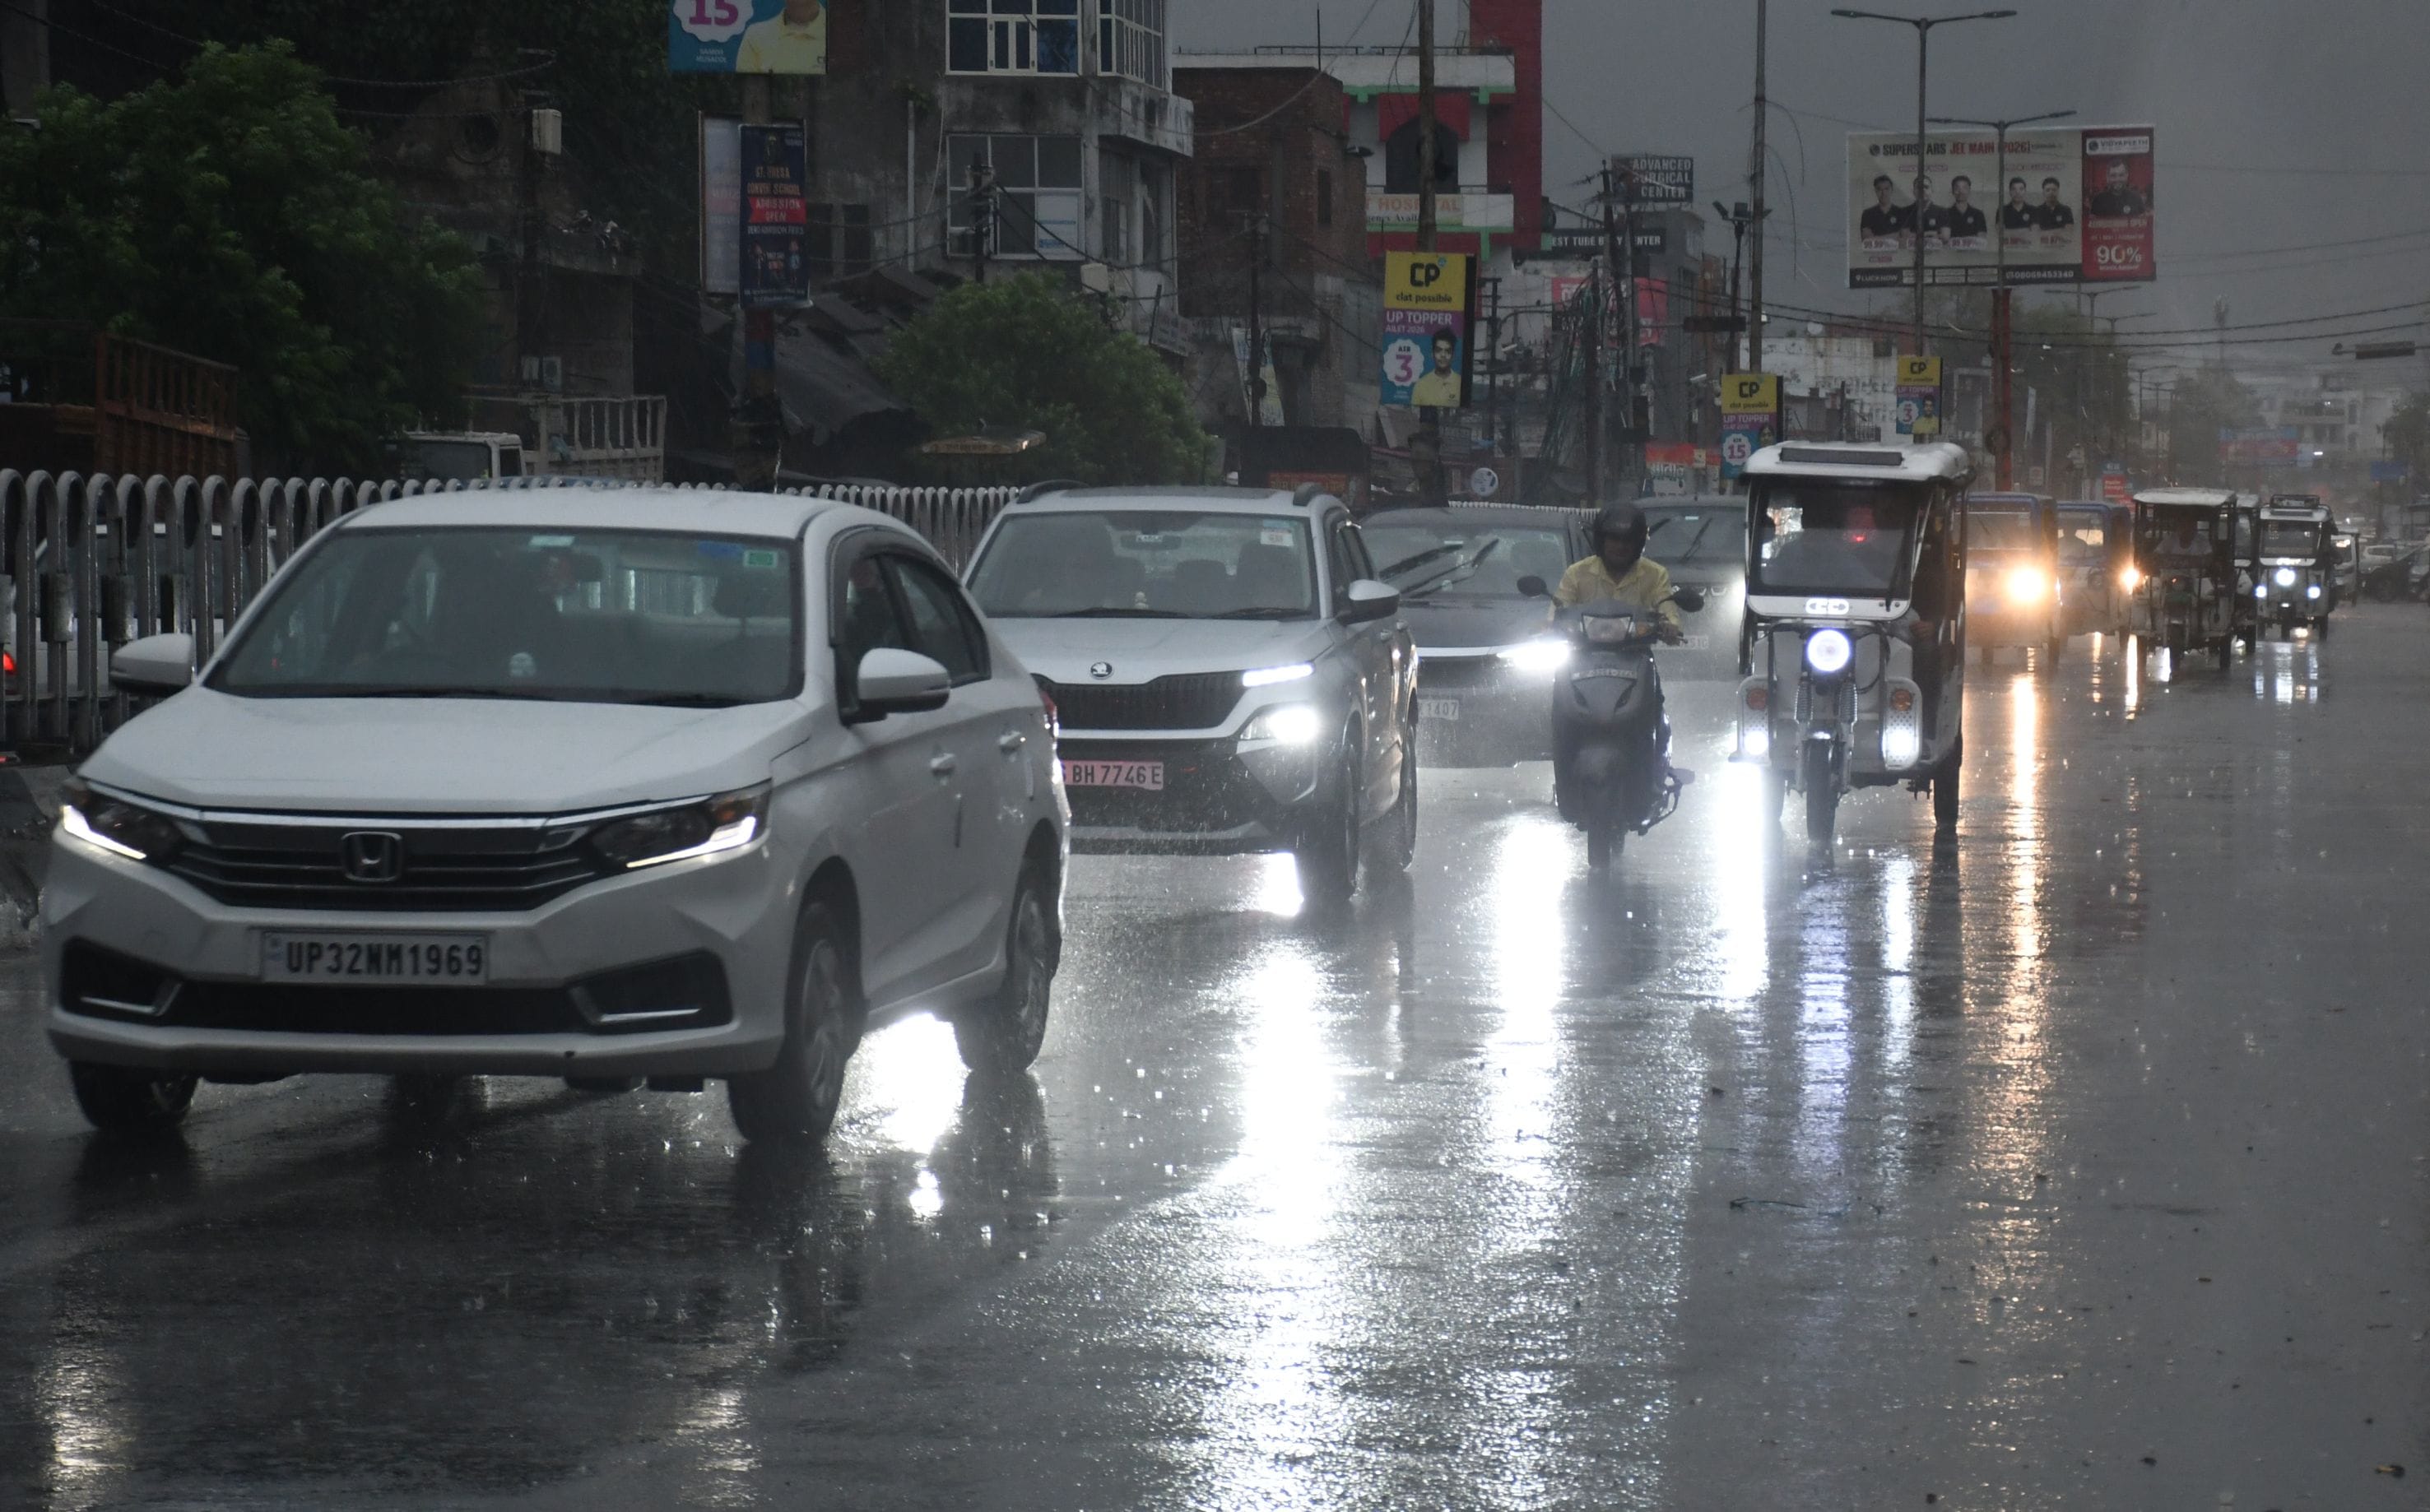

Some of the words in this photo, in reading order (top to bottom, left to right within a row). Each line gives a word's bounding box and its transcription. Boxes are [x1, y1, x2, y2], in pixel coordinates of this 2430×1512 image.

[689, 0, 738, 26] 15
[1882, 142, 1947, 155] SUPERSARS
[1968, 141, 1995, 154] MAIN
[2100, 139, 2149, 149] VIDYAPEETH
[1632, 158, 1691, 171] ADVANCED
[1632, 171, 1690, 184] SURGICAL
[1641, 186, 1686, 198] CENTER
[1552, 235, 1568, 247] EST
[2096, 245, 2143, 264] 90%
[1410, 262, 1441, 288] CP
[1861, 274, 1898, 282] LUCKNOW
[1396, 291, 1413, 303] clat
[1415, 293, 1453, 304] possible
[1386, 311, 1403, 323] UP
[1406, 312, 1453, 326] TOPPER
[1394, 355, 1413, 383] 3
[1909, 361, 1927, 375] CP
[1739, 382, 1760, 398] CP
[1723, 415, 1736, 424] UP
[1738, 414, 1770, 423] TOPPER
[1903, 408, 1913, 423] 3
[1727, 444, 1746, 460] 15
[1072, 764, 1095, 784] BH
[1100, 764, 1147, 784] 7746
[1151, 765, 1163, 784] E
